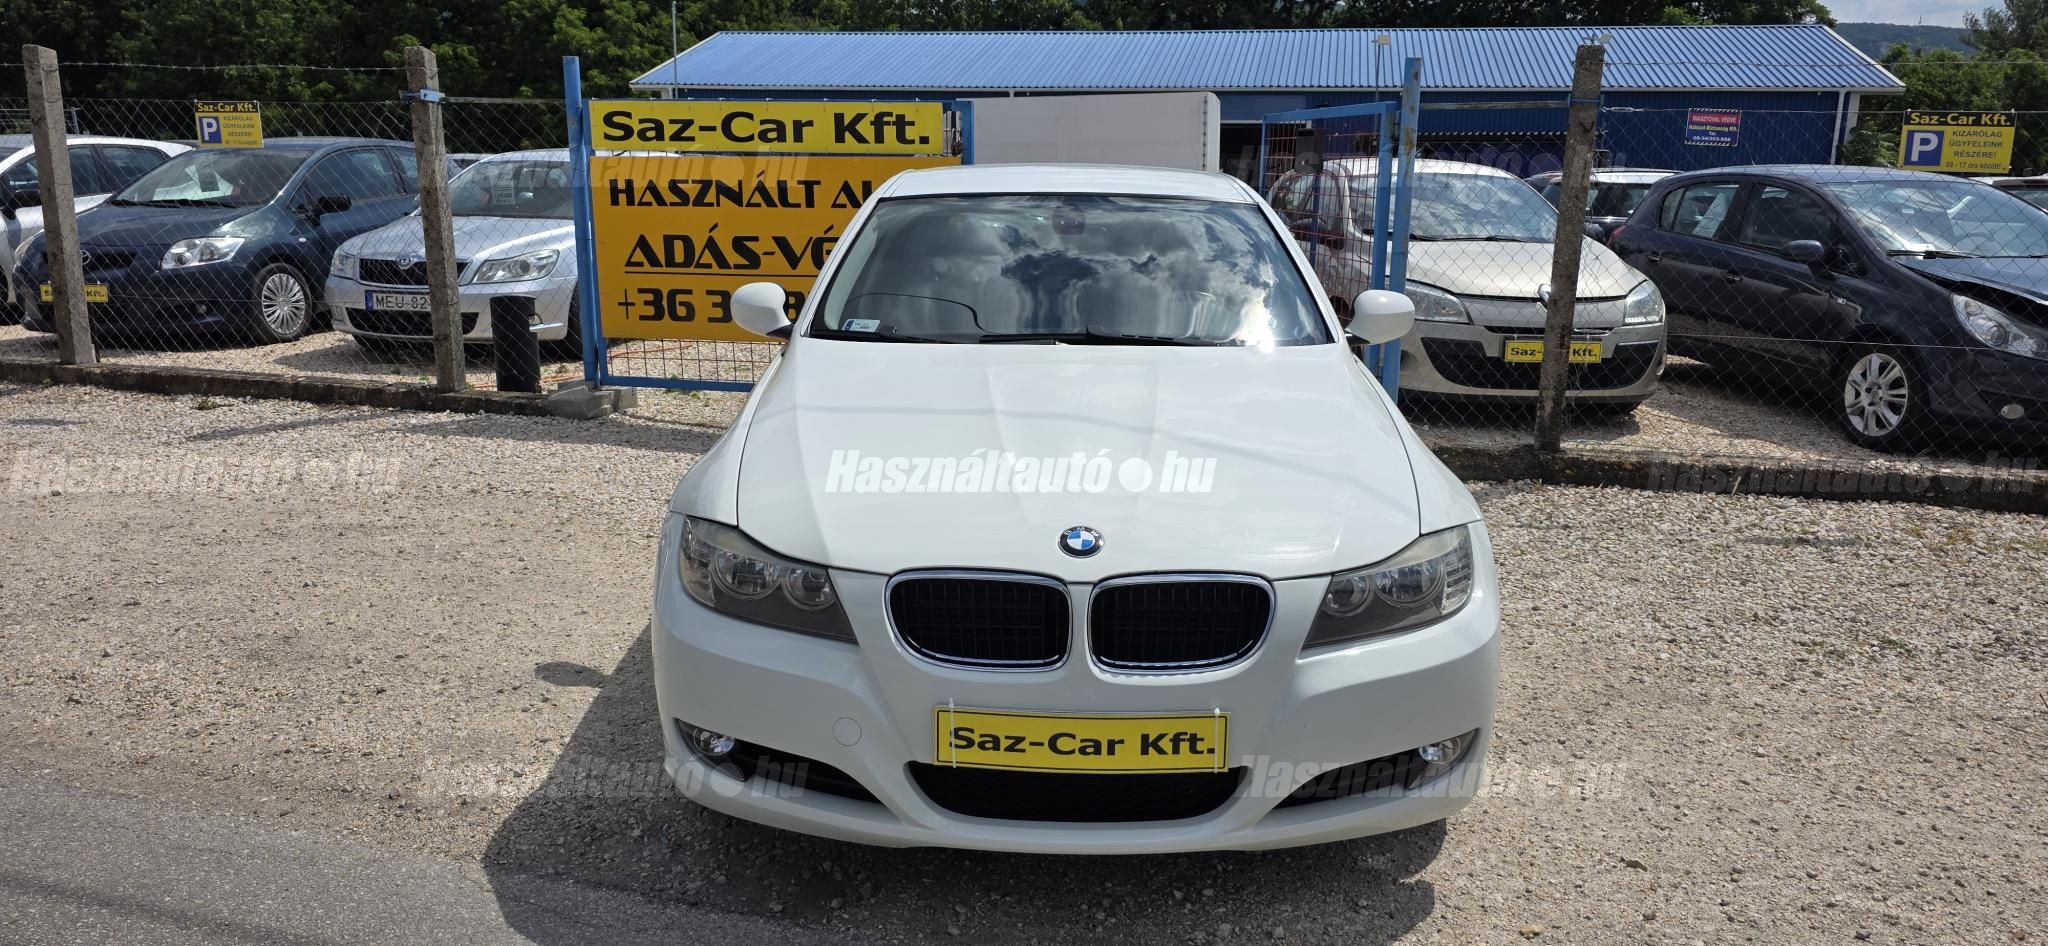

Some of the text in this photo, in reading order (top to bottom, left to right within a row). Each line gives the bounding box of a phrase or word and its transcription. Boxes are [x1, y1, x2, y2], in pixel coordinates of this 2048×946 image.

[197, 102, 256, 112] Saz-Car Kft.
[1909, 112, 2011, 126] Saz-Car Kft.
[201, 117, 218, 141] P
[603, 110, 930, 145] Saz-Car Kft.
[1910, 131, 1939, 162] P
[1949, 140, 2003, 149] ÜGYFELEINK
[609, 169, 821, 209] HASZNÁLT
[624, 222, 841, 271] ADÁS-VÉ
[375, 295, 428, 310] MEU-82
[617, 287, 696, 323] +36
[705, 289, 733, 324] 3
[1572, 348, 1597, 357] Kft.
[949, 726, 1217, 757] Saz-Car Kft.
